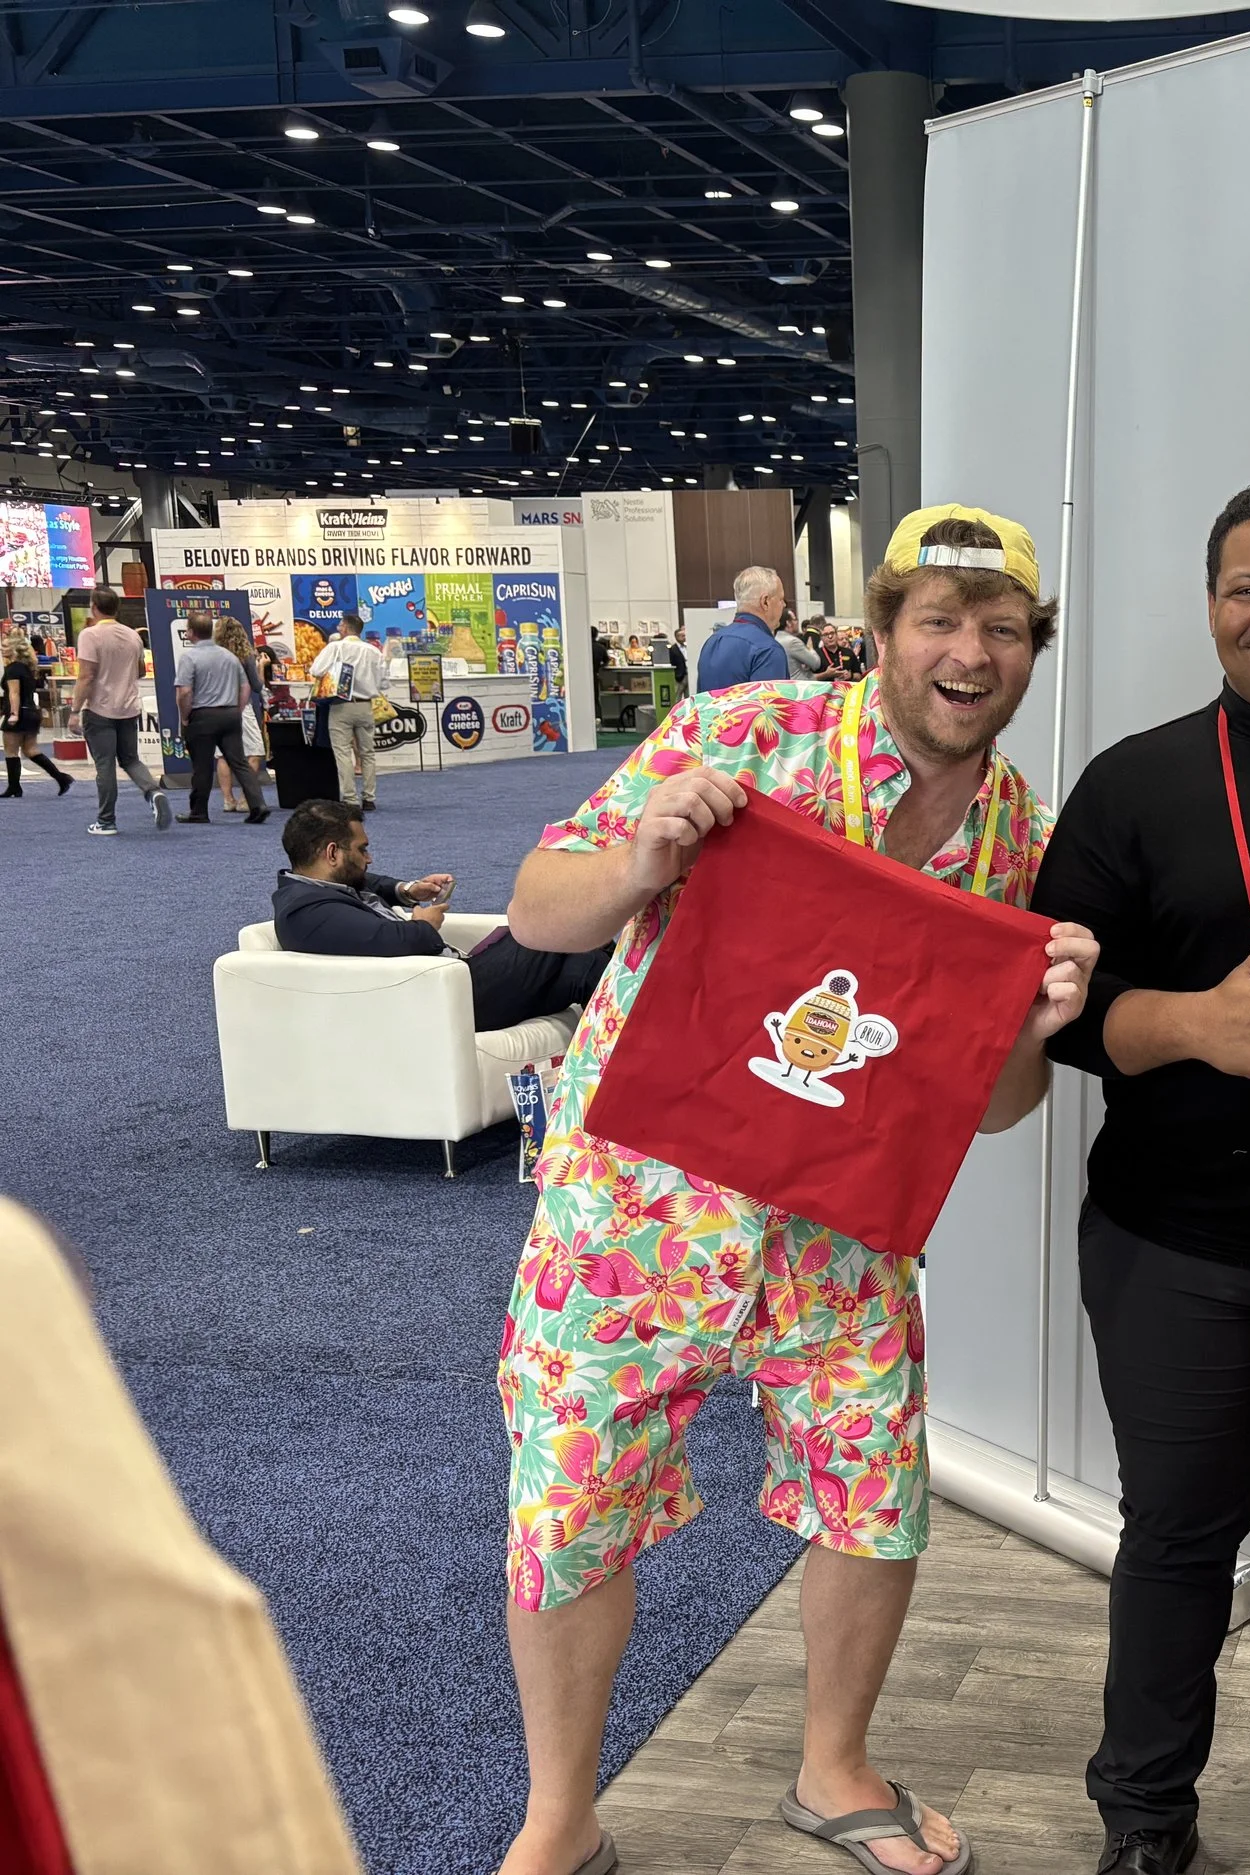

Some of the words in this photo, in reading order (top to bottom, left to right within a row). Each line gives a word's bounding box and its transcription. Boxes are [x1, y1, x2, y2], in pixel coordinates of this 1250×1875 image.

[521, 512, 558, 524] MARS
[563, 512, 584, 524] SN
[60, 520, 81, 532] Style
[184, 548, 250, 567] BELOVED
[255, 548, 317, 567] BRANDS
[322, 548, 386, 567] DRIVING
[391, 548, 451, 566] FLAVOR
[456, 547, 532, 566] FORWARD
[434, 582, 483, 594] PRIMAL
[166, 599, 203, 609] CULINARY
[205, 598, 231, 609] LUNCH
[309, 610, 343, 619] DELUXE
[500, 712, 522, 728] Kraft
[805, 1016, 838, 1031] IDAHOAN
